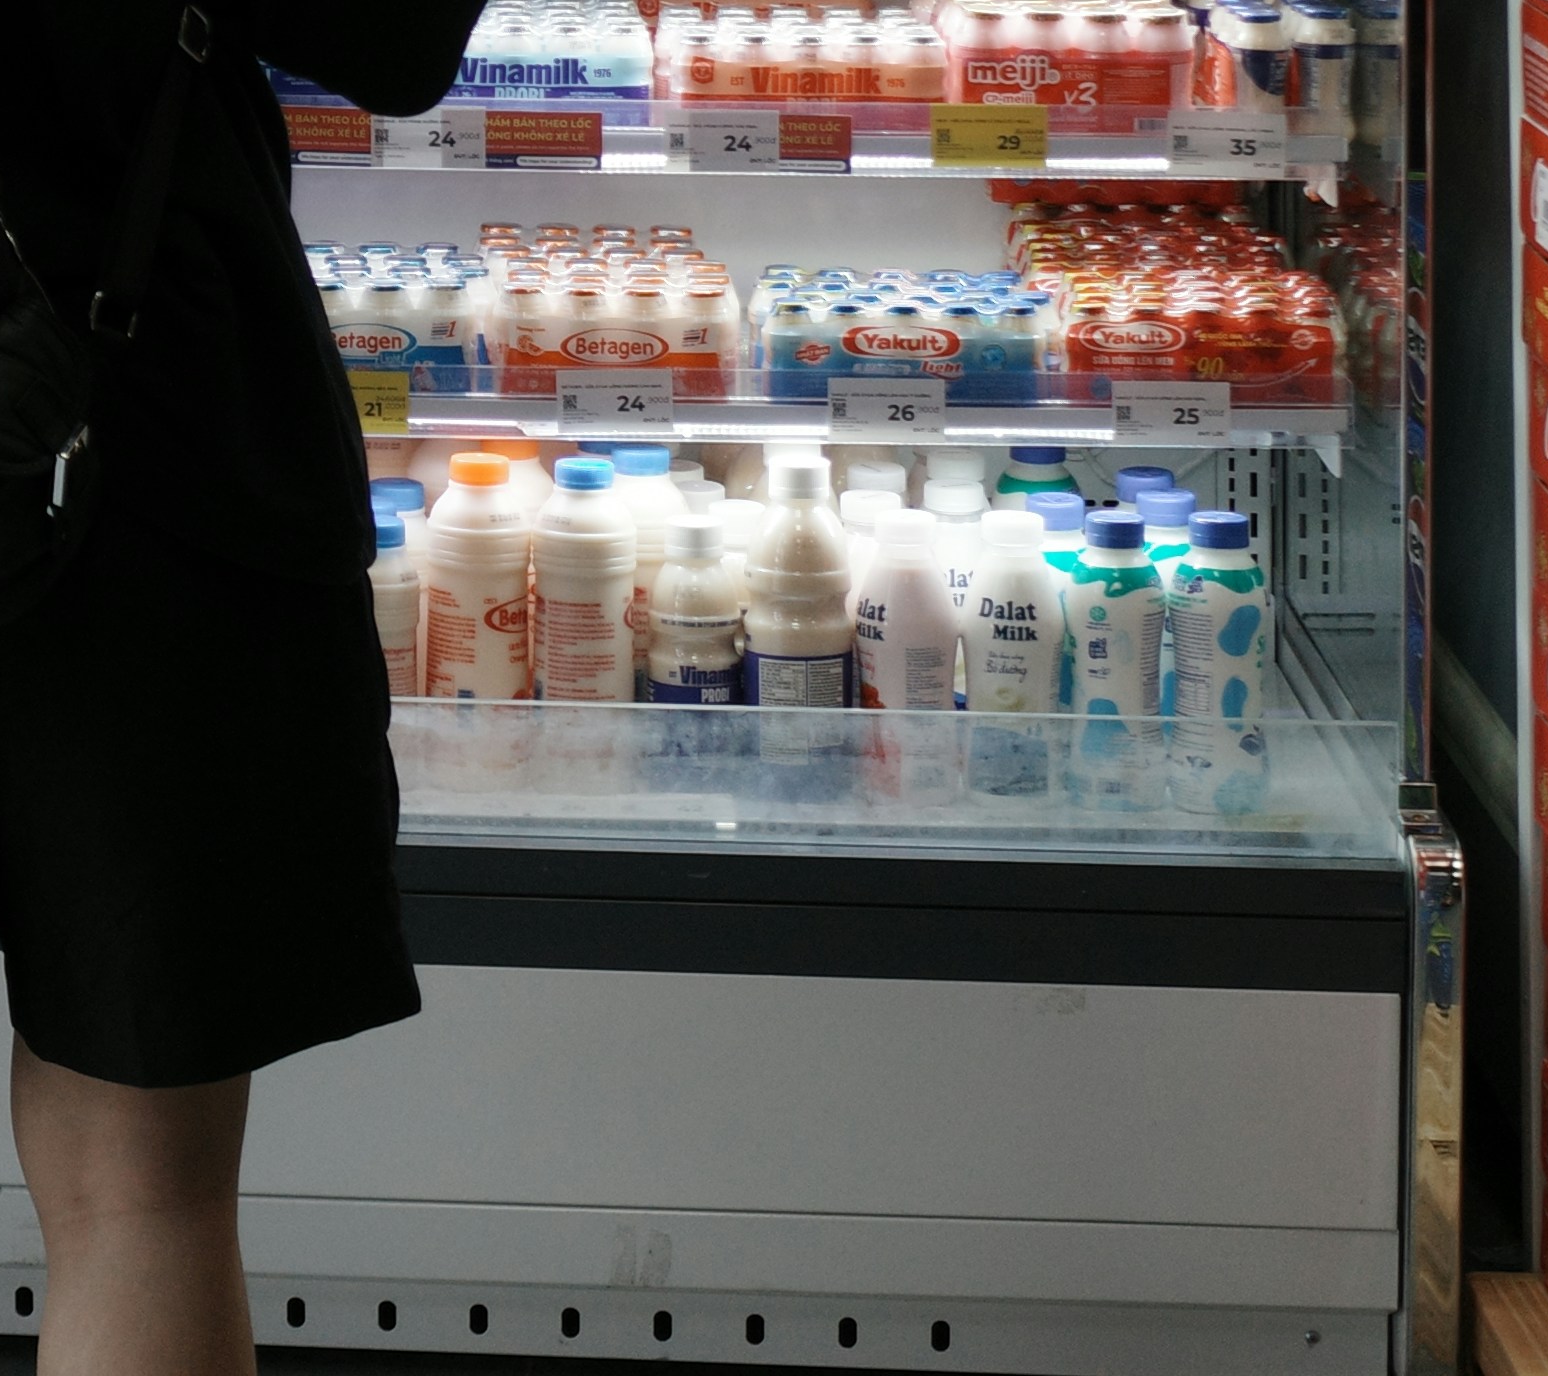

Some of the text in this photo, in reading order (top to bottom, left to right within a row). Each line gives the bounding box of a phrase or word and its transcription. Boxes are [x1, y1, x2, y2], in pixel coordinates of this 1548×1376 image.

[575, 336, 654, 357] Betagen
[860, 329, 947, 352] Yakult
[1173, 408, 1200, 424] 25
[979, 597, 1036, 622] Dalat
[993, 622, 1038, 641] Milk
